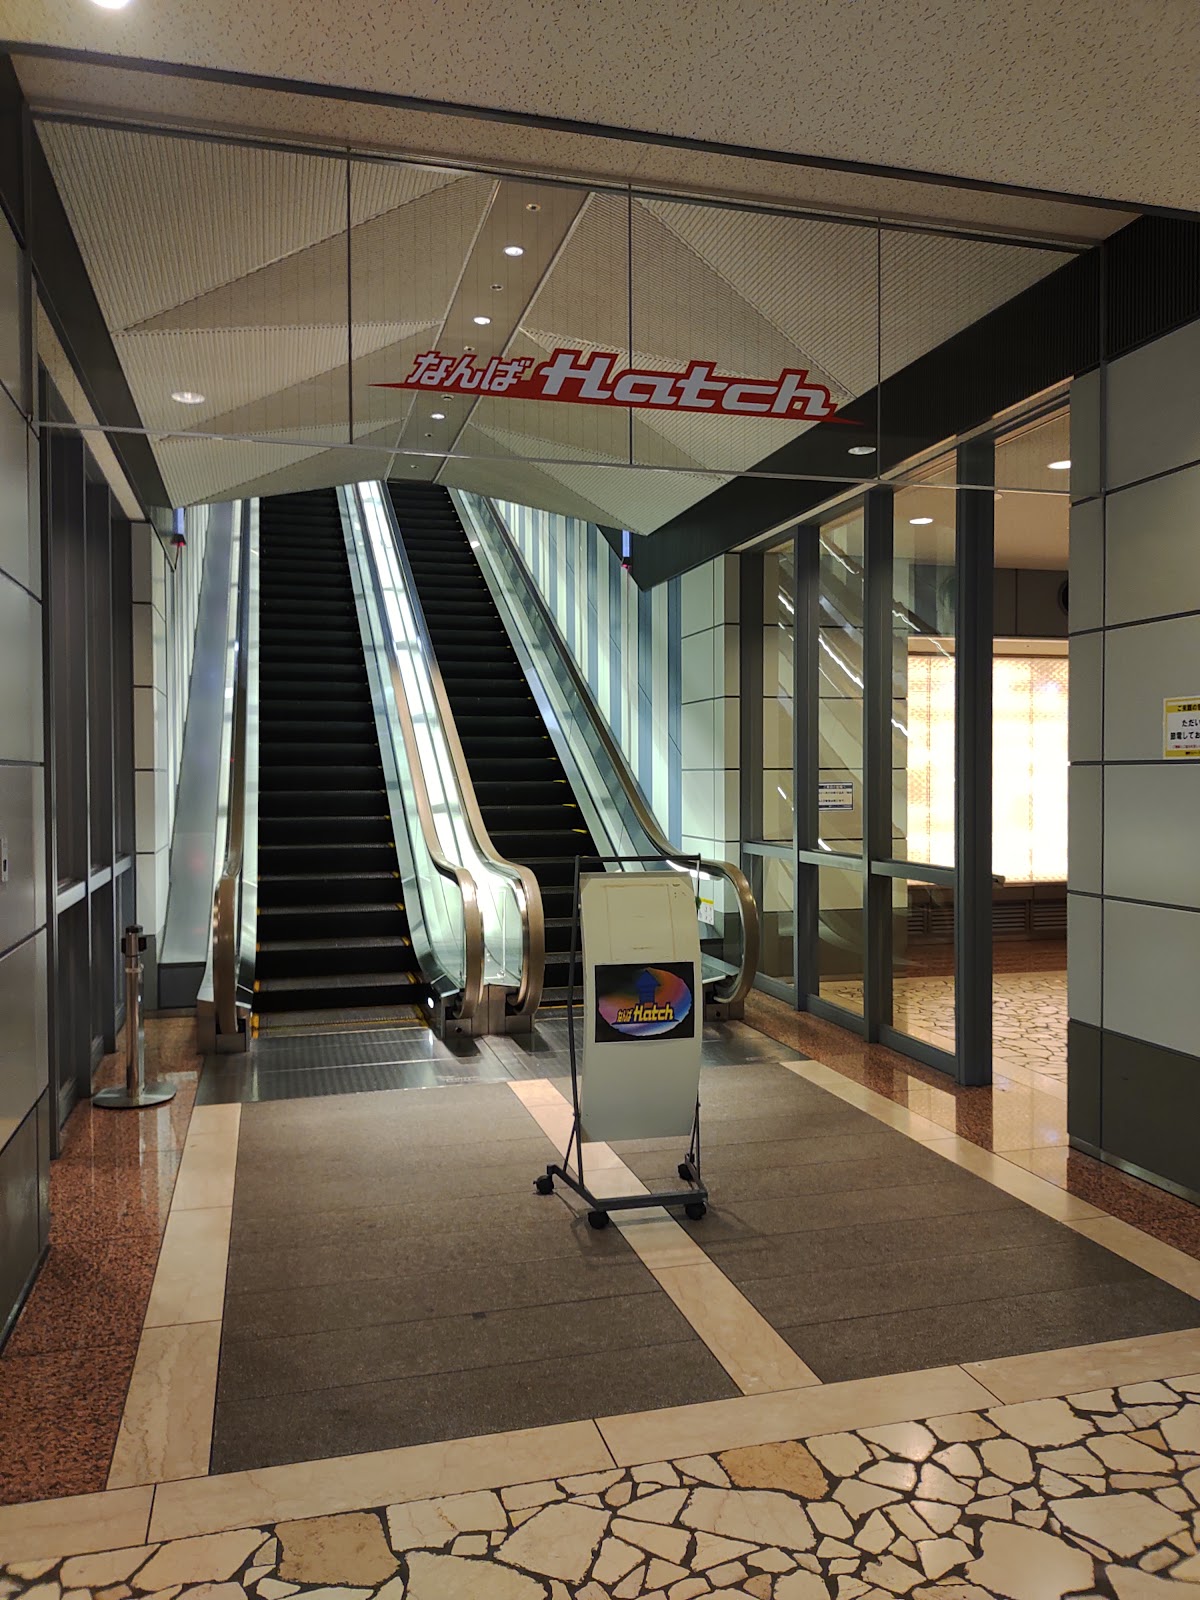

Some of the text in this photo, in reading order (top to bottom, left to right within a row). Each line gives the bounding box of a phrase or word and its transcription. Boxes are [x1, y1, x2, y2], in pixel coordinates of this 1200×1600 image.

[407, 352, 831, 417] なんば Hatch
[633, 1003, 674, 1022] Hatch
